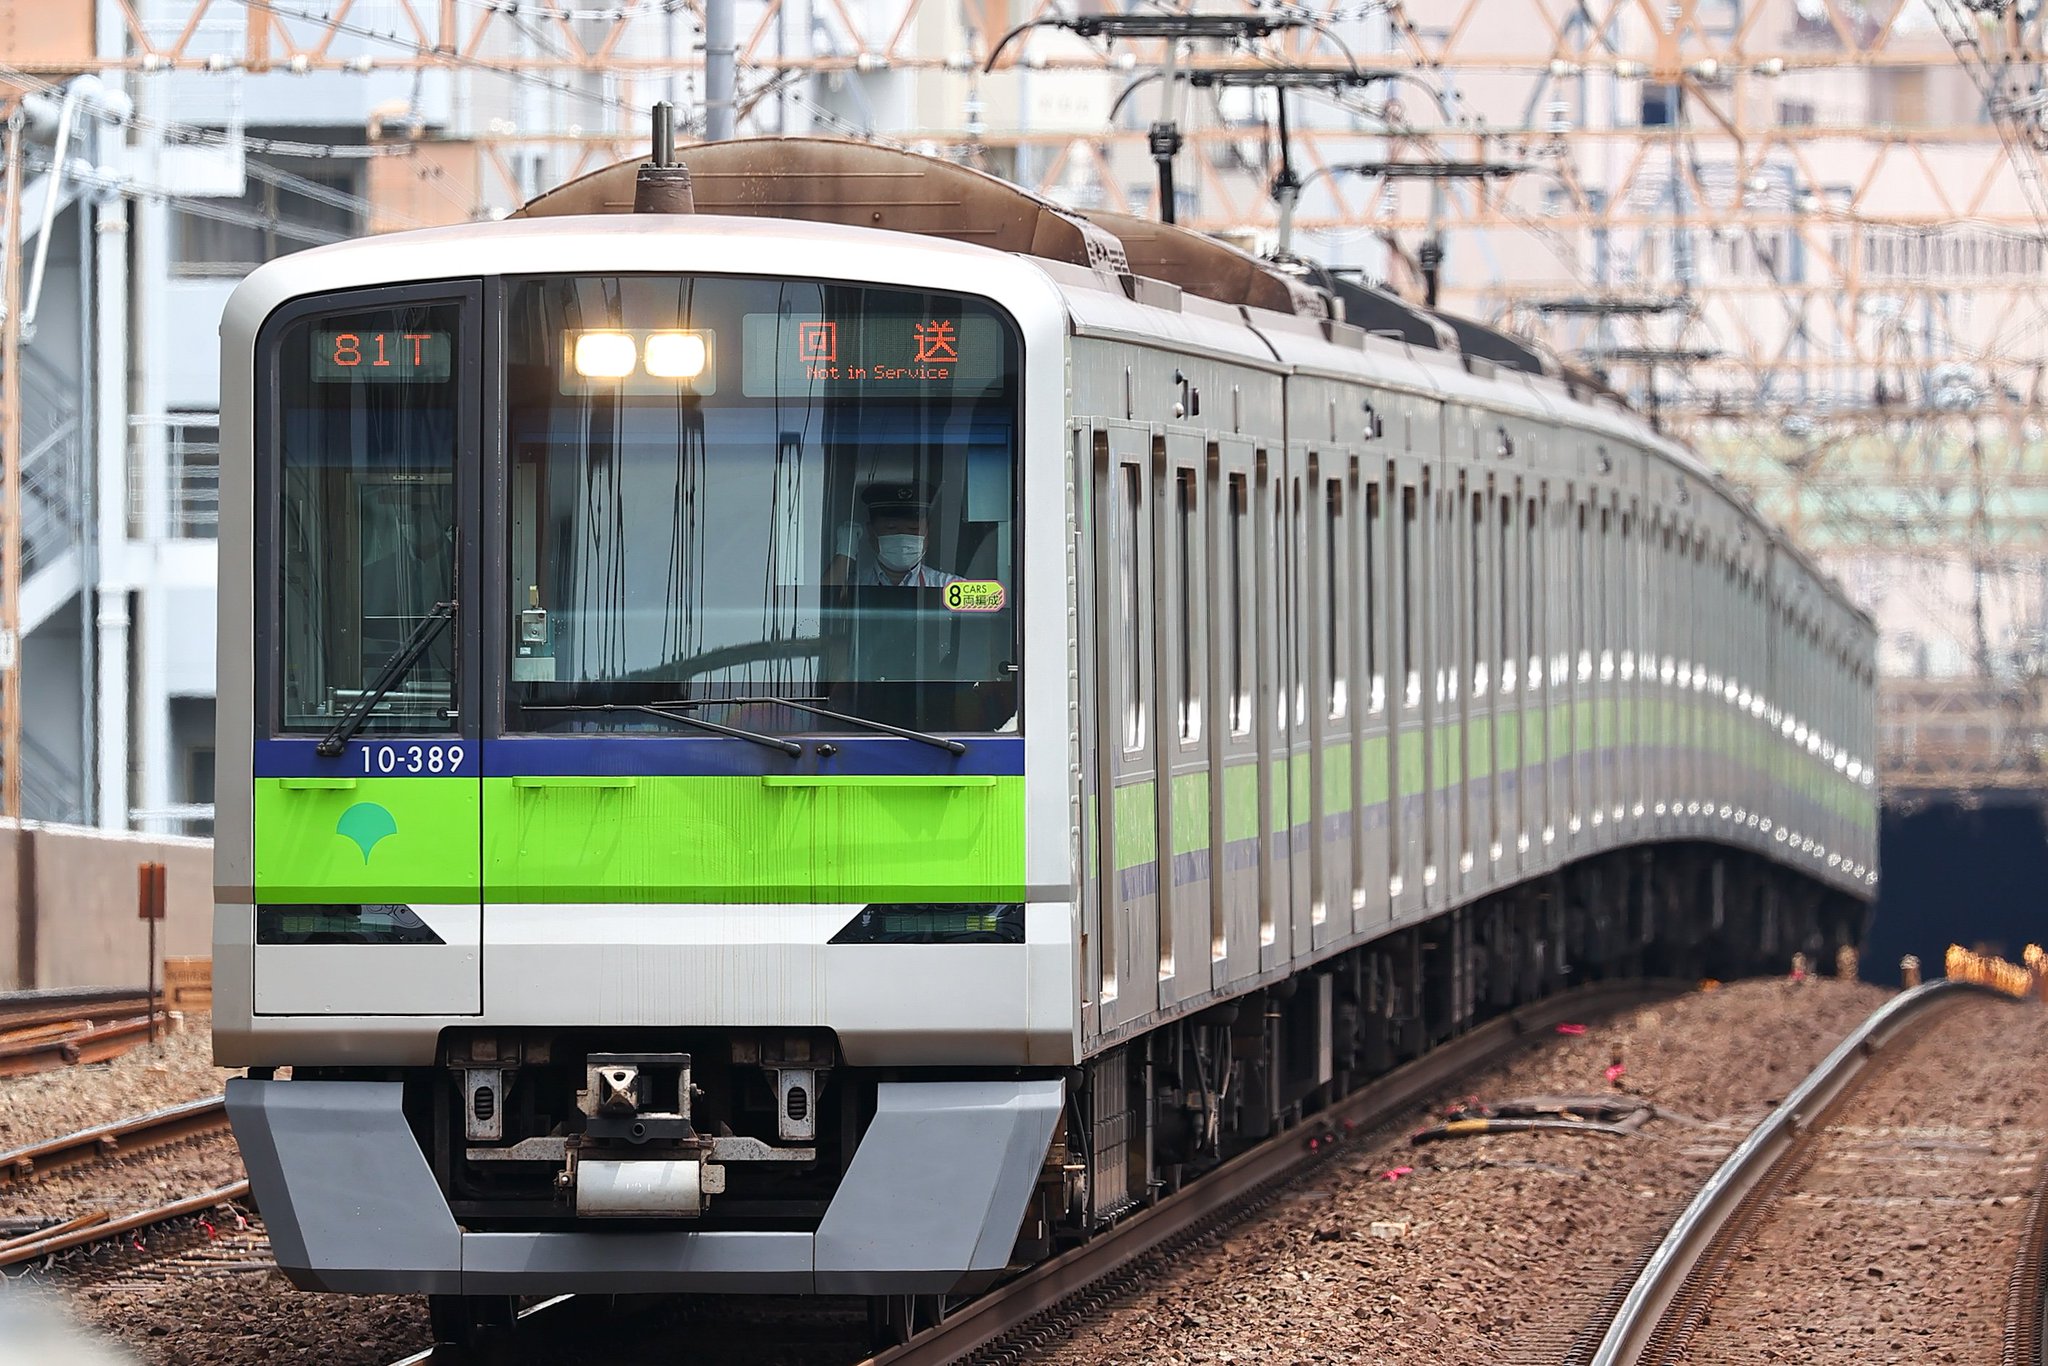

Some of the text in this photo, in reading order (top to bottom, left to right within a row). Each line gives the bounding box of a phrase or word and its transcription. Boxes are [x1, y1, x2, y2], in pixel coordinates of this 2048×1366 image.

[333, 333, 432, 366] 81T
[806, 364, 949, 380] Not in Service
[949, 585, 987, 606] 8 CARS
[360, 746, 465, 774] 10-389
